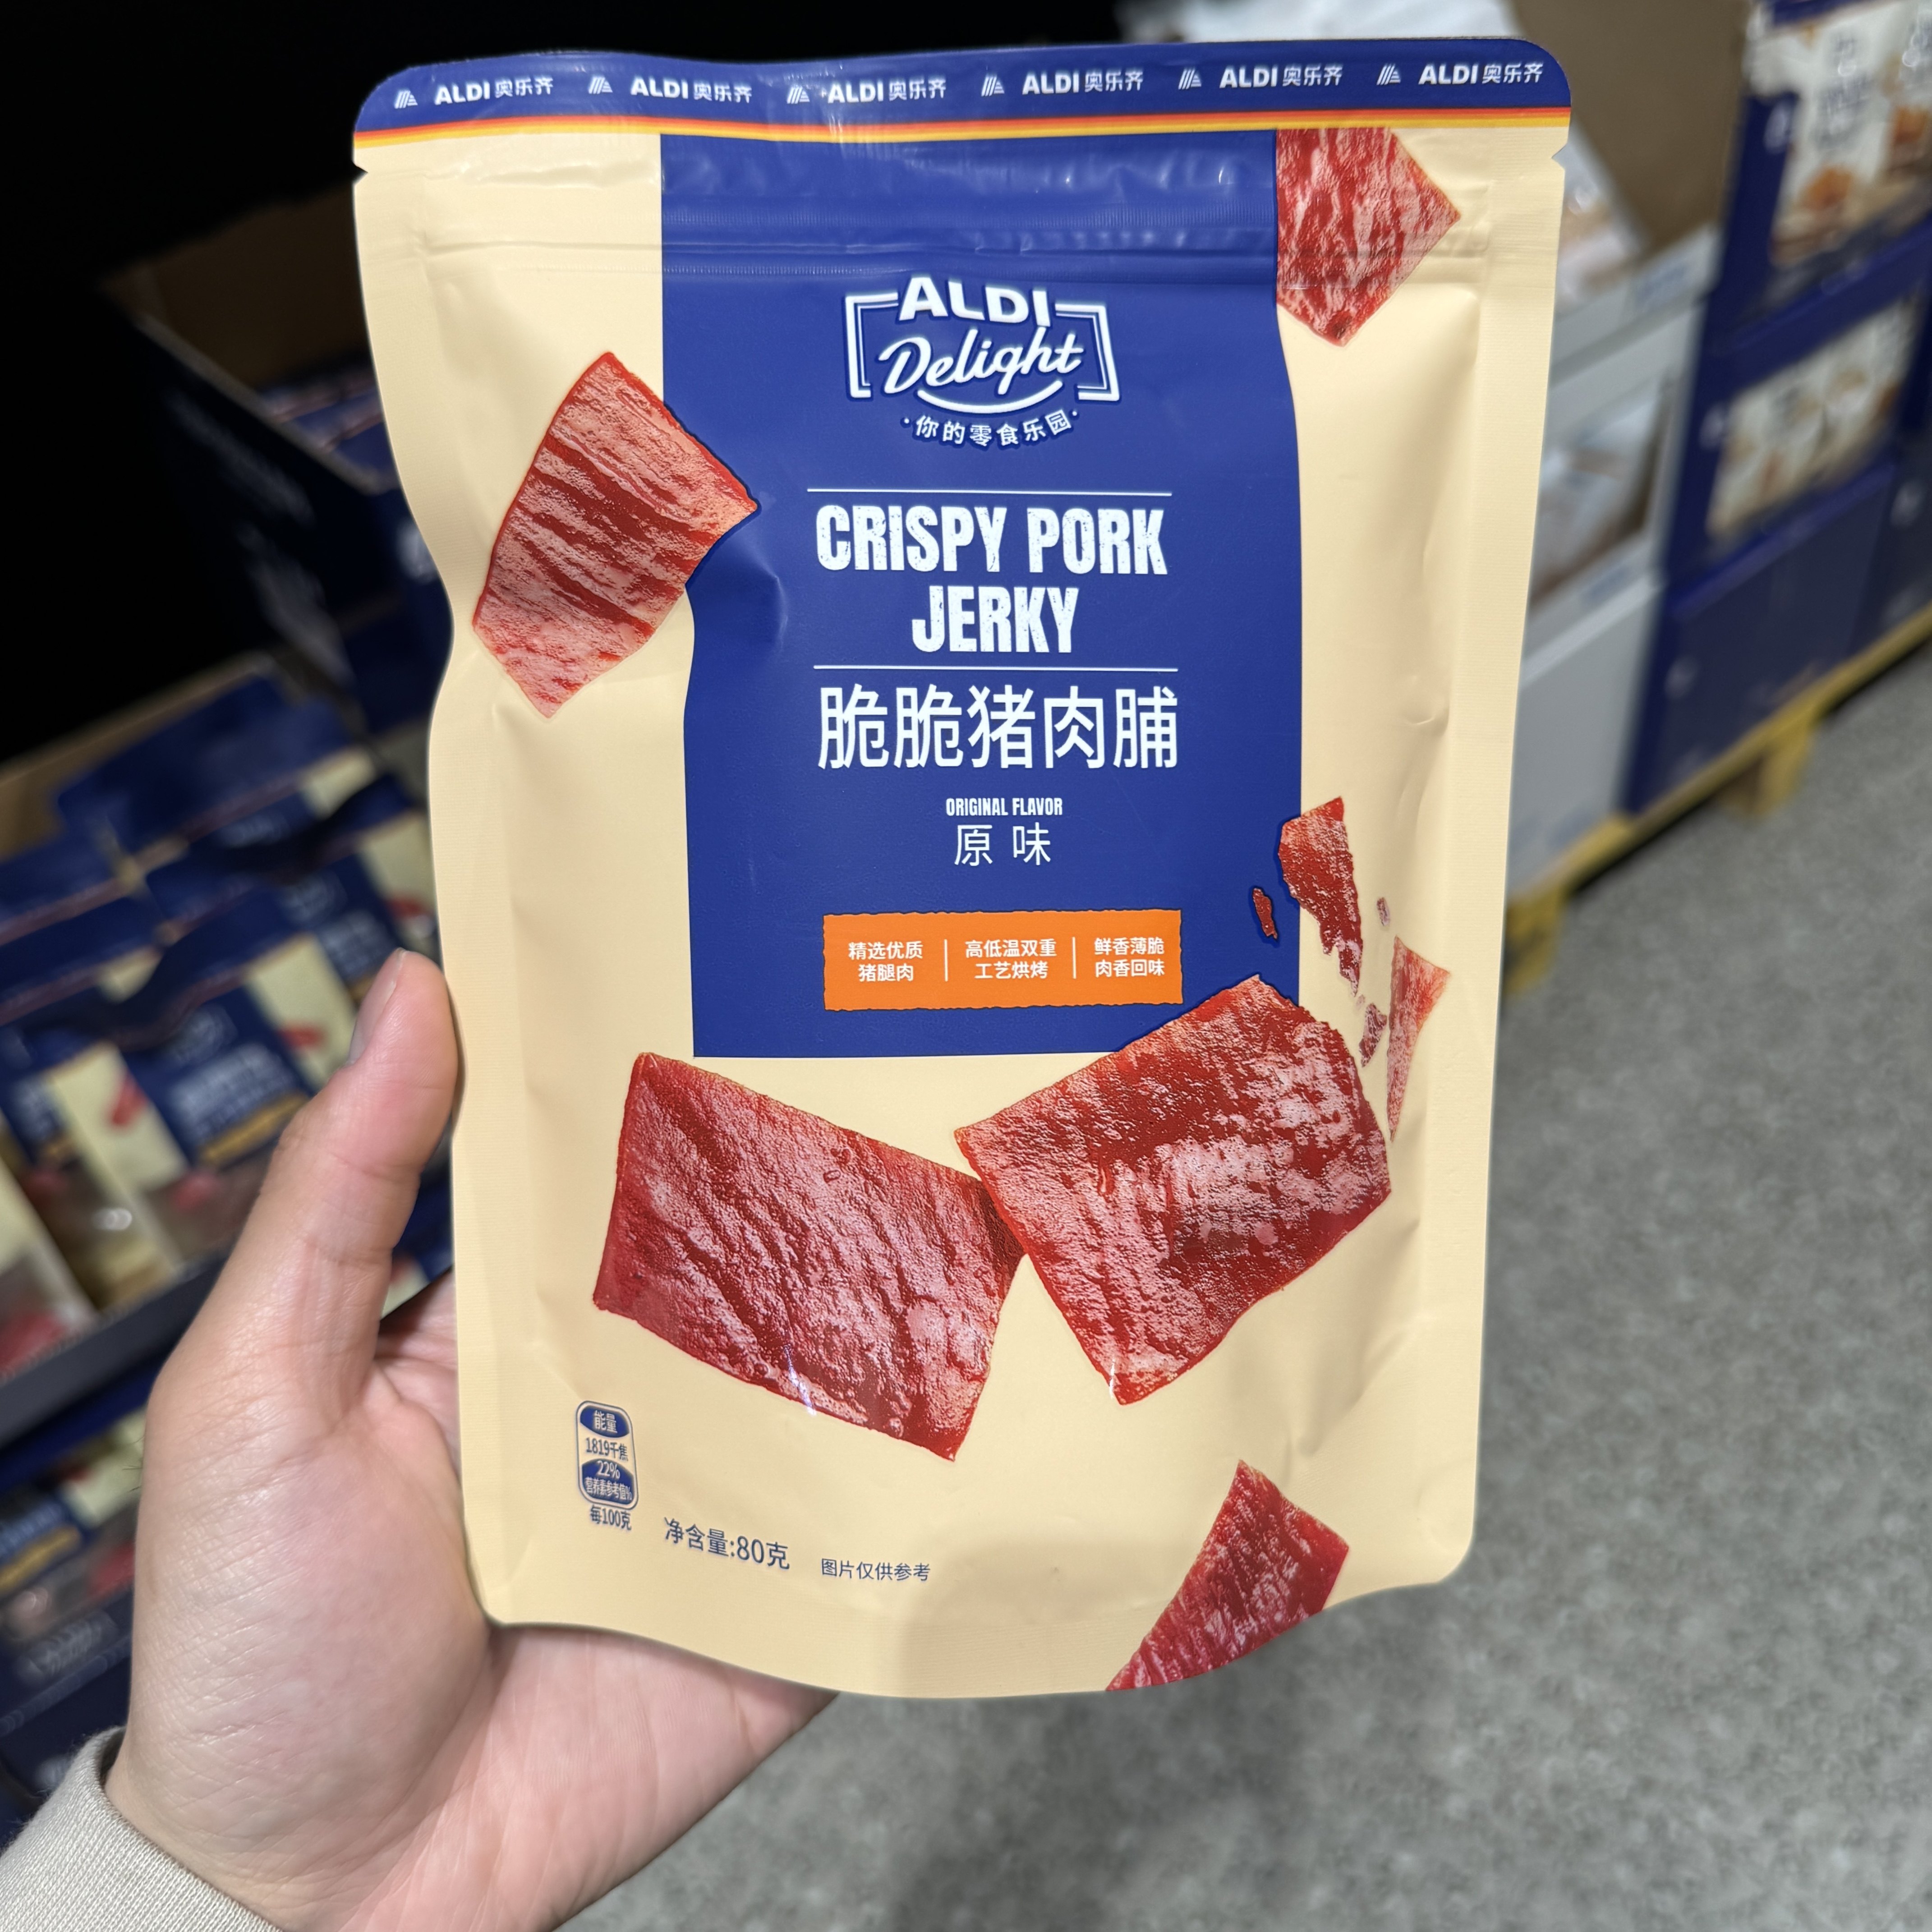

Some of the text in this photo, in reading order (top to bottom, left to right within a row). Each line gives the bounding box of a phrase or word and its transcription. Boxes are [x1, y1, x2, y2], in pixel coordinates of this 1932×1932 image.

[435, 82, 490, 105] ALDI
[630, 78, 688, 99] ALDI
[826, 82, 883, 103] ALDI
[1022, 73, 1079, 95] ALDI
[1219, 67, 1278, 88] ALDI
[1418, 64, 1478, 84] ALDI
[899, 276, 1051, 327] ALDI
[878, 326, 1084, 395] Delight
[816, 505, 1168, 575] CRISPY PORK
[911, 585, 1079, 653] JERKY
[818, 683, 1178, 769] 脆脆猪肉脯
[946, 797, 1063, 816] ORIGINAL FLAVOR
[954, 822, 1051, 866] 原味
[848, 941, 923, 960] 精选优质
[965, 938, 1057, 958] 高低温双重
[1094, 937, 1164, 956] 鲜香薄脆
[858, 963, 914, 982] 猪腿肉
[974, 960, 1049, 979] 工艺烘烤
[1095, 958, 1165, 978] 肉香回味
[593, 1410, 617, 1433] 能量
[586, 1437, 628, 1462] 1819千焦
[597, 1460, 620, 1479] 22%
[590, 1504, 632, 1531] 每100克
[664, 1517, 790, 1570] 净含量:80克
[821, 1558, 930, 1582] 图片仅供参考
